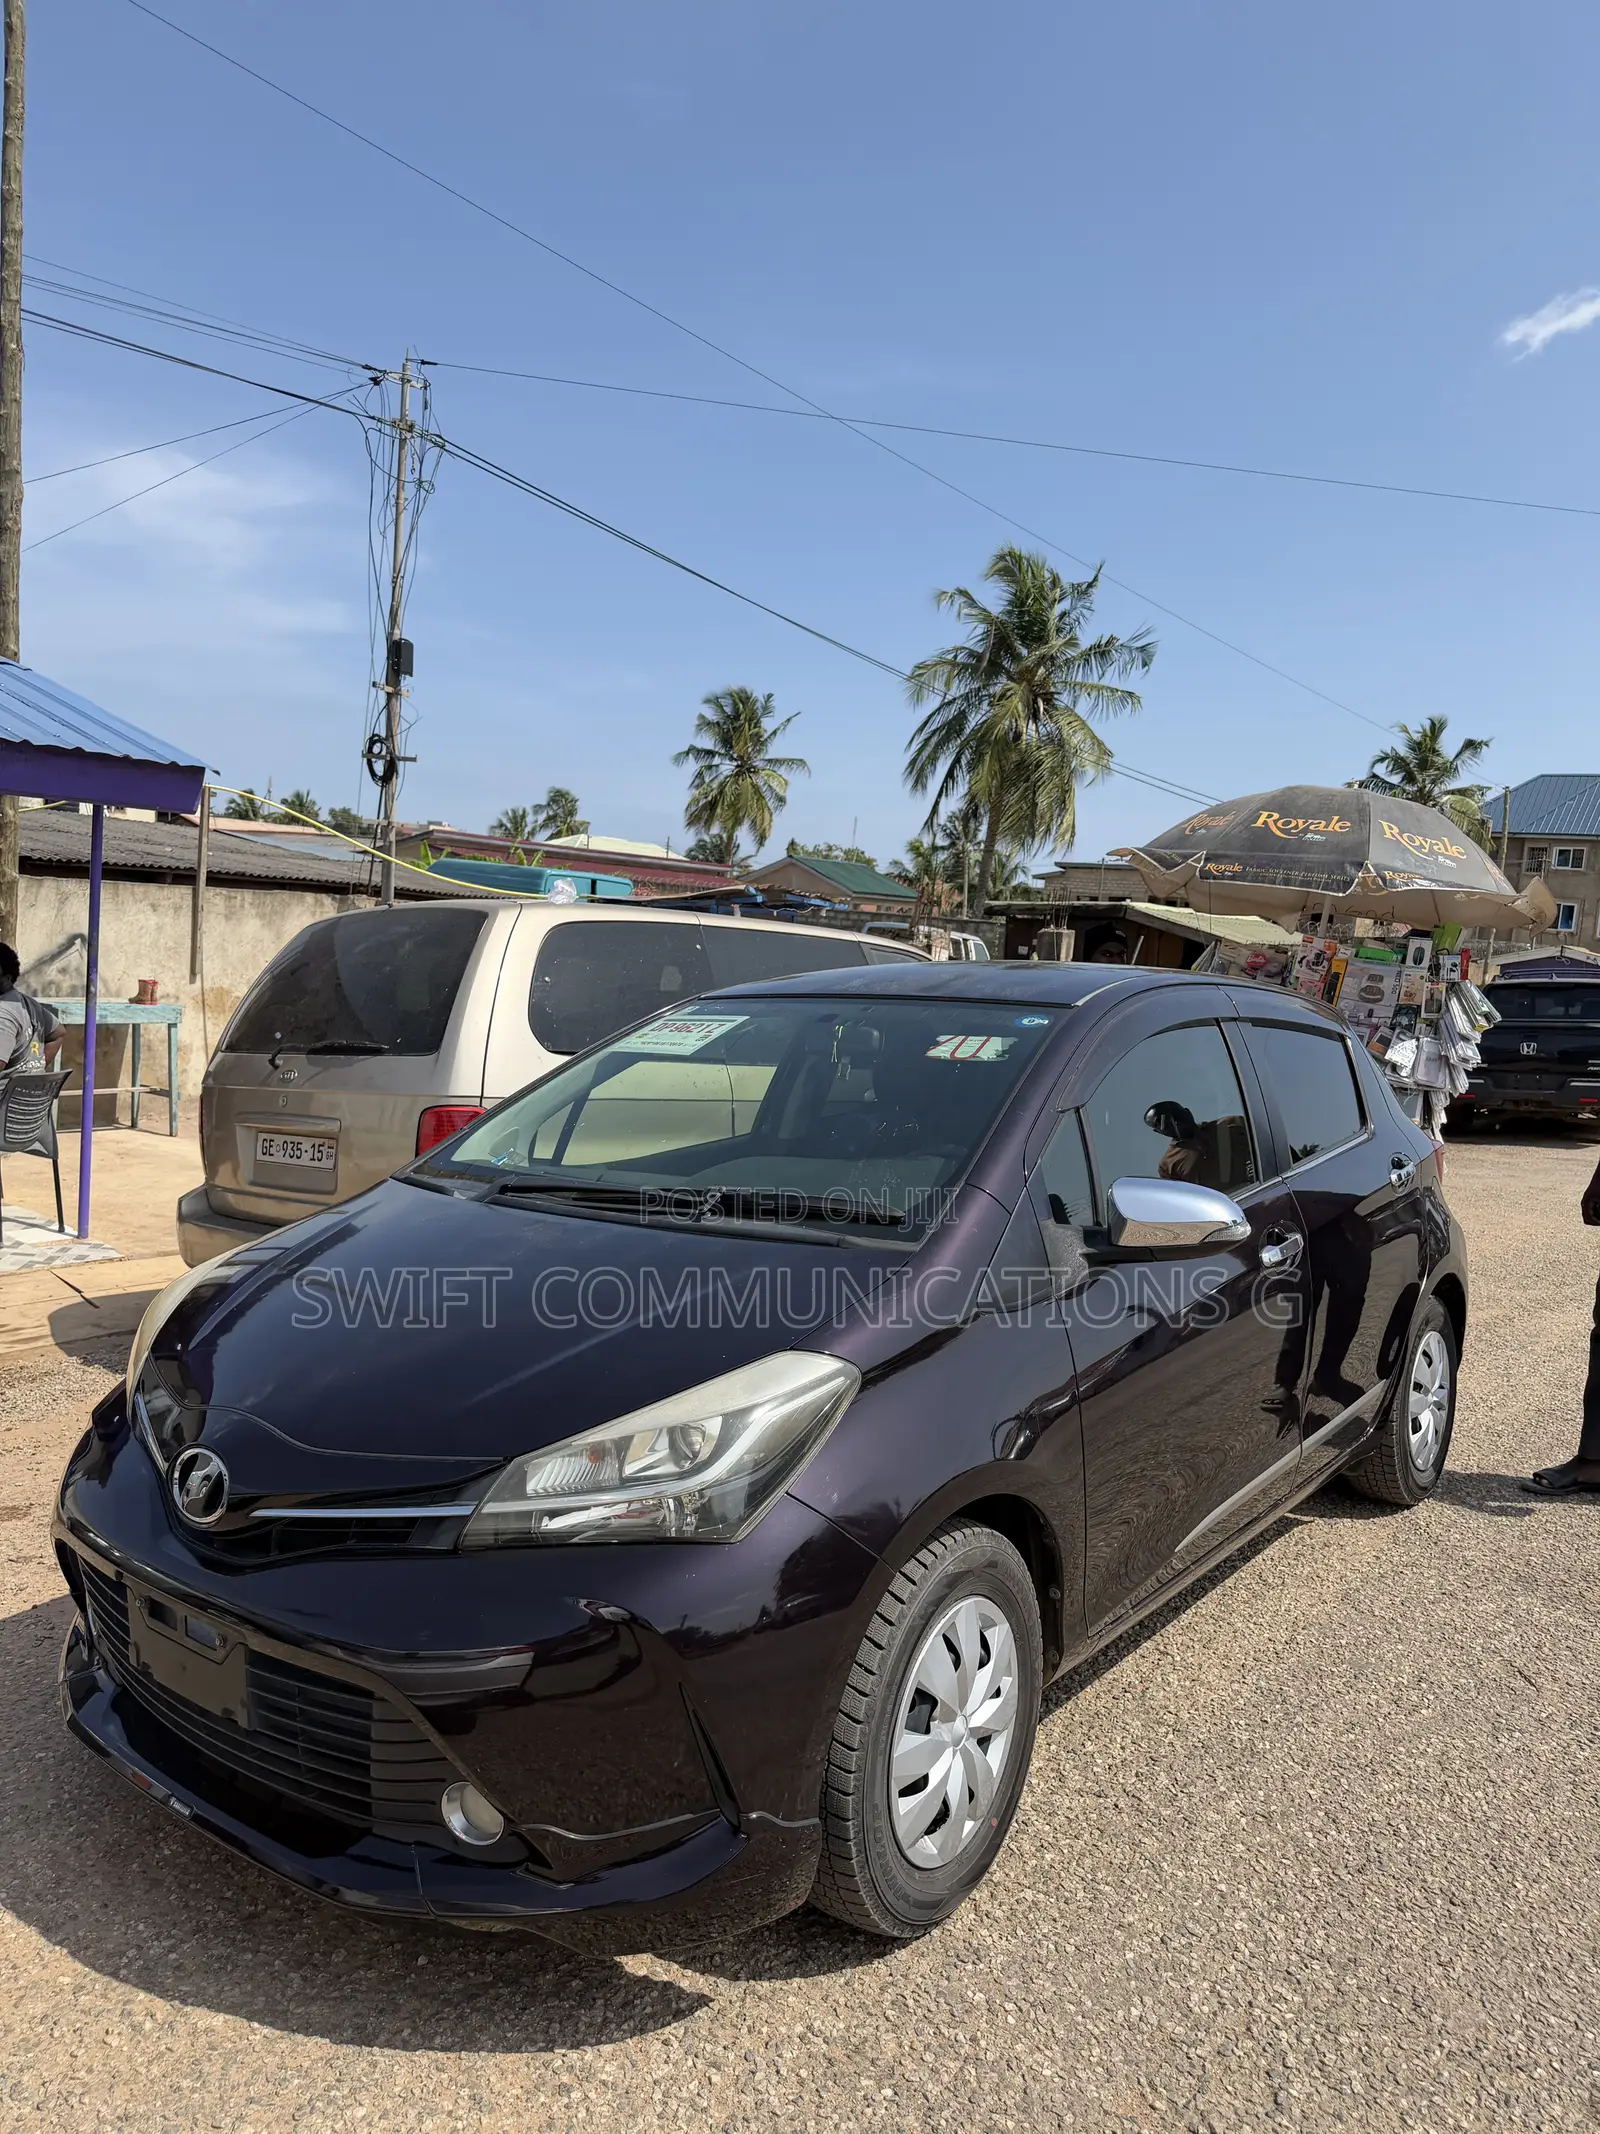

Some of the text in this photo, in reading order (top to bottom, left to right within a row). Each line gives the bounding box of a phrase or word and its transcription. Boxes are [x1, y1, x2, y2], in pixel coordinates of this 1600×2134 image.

[1251, 810, 1351, 839] Royale
[1378, 819, 1467, 860] Royale
[261, 1138, 275, 1157] GE
